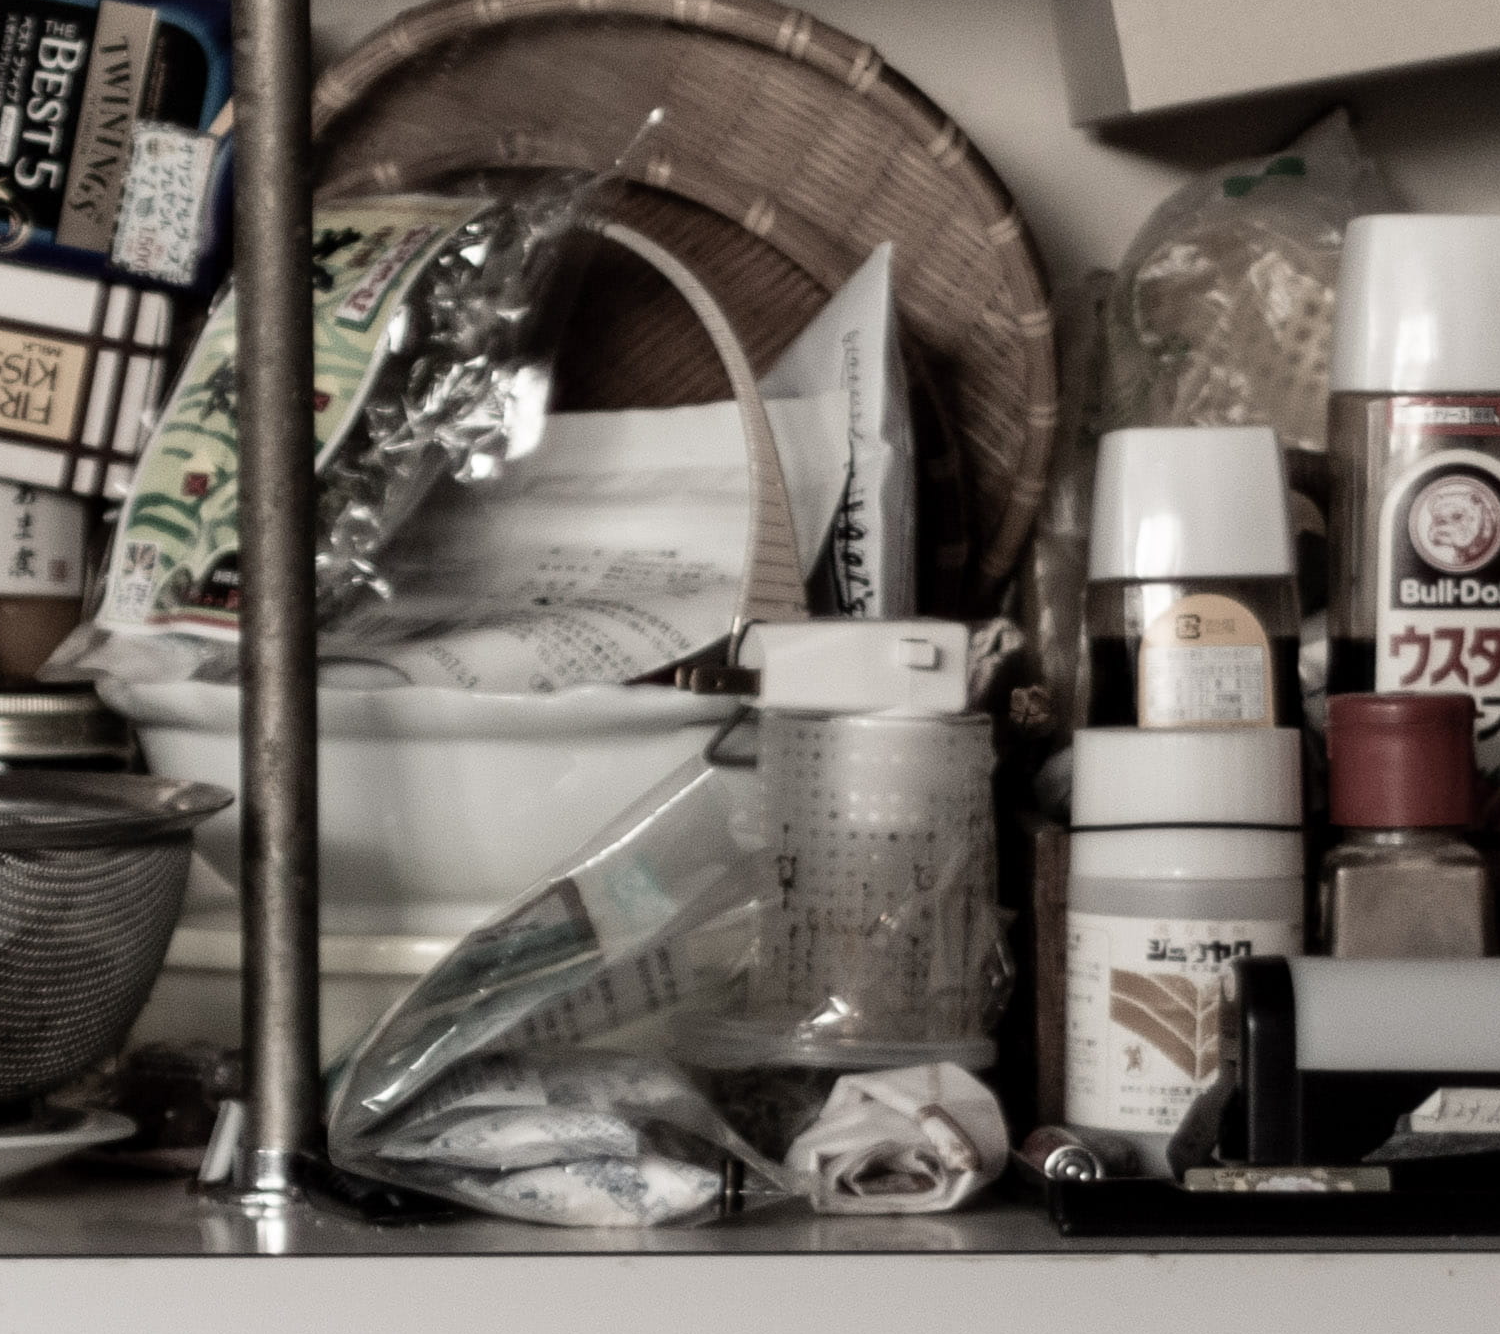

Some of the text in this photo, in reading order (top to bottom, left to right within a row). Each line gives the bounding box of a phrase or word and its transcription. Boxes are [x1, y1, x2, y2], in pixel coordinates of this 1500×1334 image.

[43, 19, 79, 39] THE
[14, 36, 87, 190] BEST 5
[68, 35, 131, 216] TWININGS
